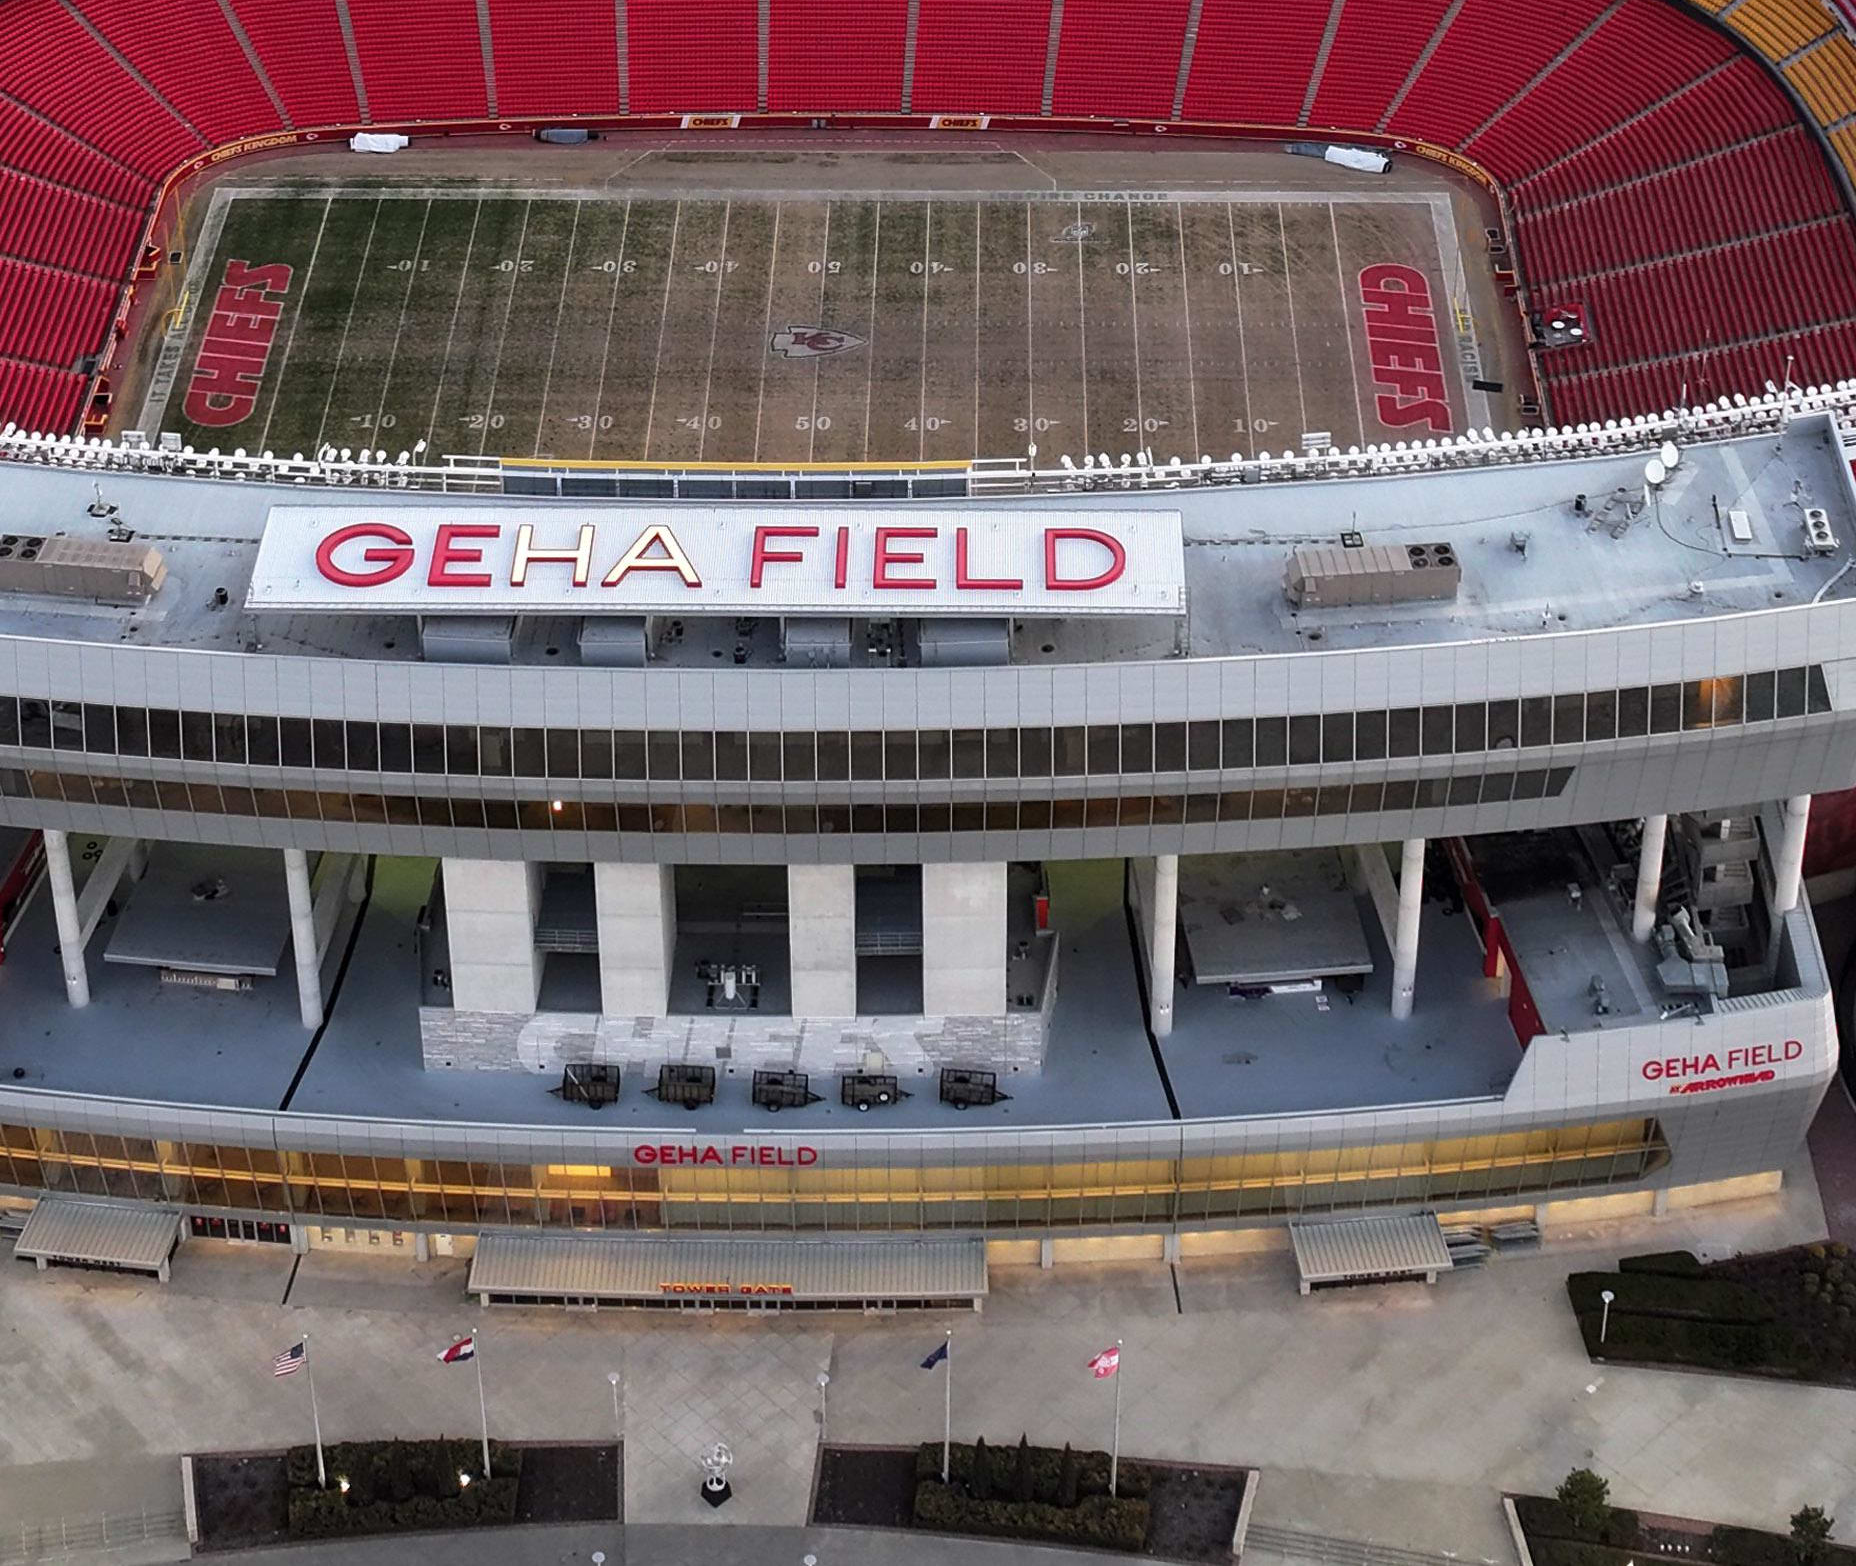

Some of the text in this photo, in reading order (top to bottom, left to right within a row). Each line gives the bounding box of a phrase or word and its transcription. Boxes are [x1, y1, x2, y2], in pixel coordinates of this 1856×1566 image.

[244, 135, 298, 151] KINGDOM
[1084, 192, 1168, 201] CHANGE
[183, 258, 293, 427] CHIEFS
[1358, 263, 1453, 433] CHIEFS
[157, 345, 179, 386] TAKES
[315, 521, 1127, 591] GEHA FIELD
[1642, 1040, 1803, 1080] GEHA FIELD
[1680, 1070, 1775, 1094] ARROWHEAD
[634, 1145, 818, 1166] GEHA FIELD
[660, 1283, 792, 1294] TOWER GATE
